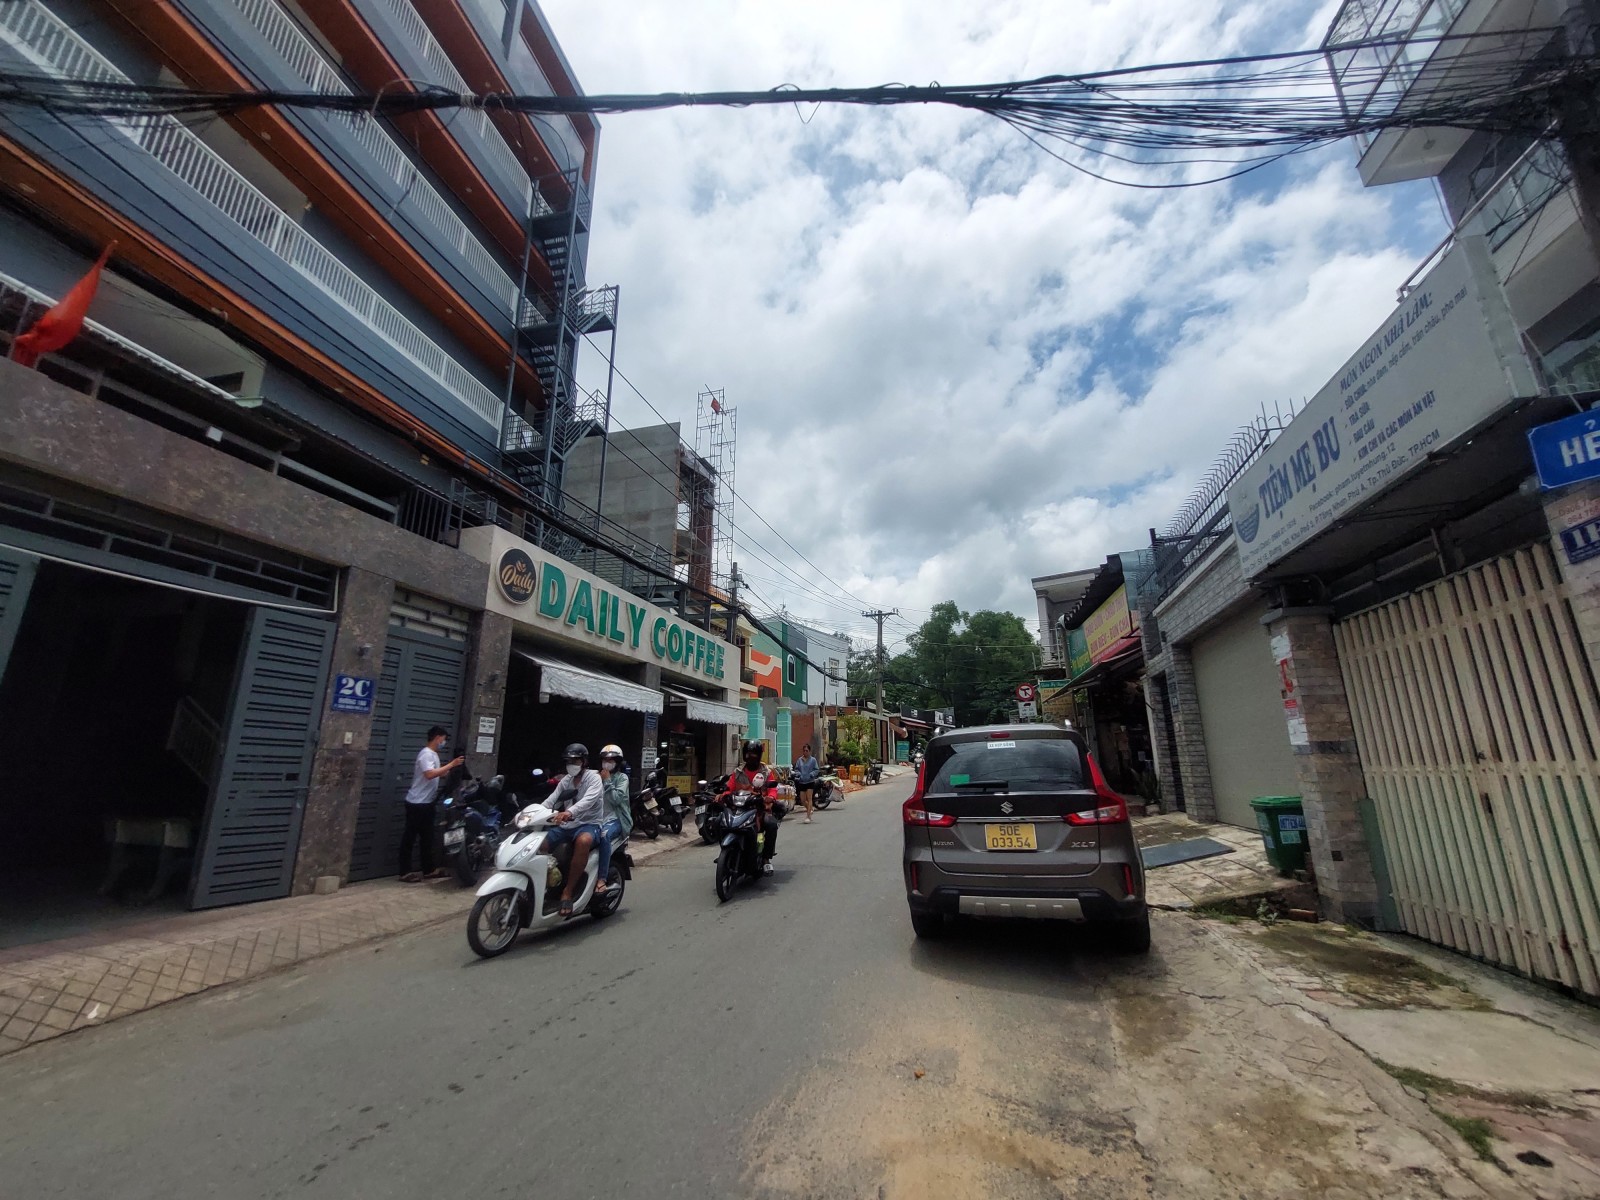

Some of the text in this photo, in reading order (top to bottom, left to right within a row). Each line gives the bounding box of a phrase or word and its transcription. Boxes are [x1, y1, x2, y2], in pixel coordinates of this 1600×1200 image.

[1408, 428, 1440, 457] TP.HCM
[1258, 416, 1340, 519] TIỆM MẸ BU
[501, 564, 535, 593] Daily
[537, 561, 725, 680] DAILY COFFEE
[338, 677, 371, 698] 2C
[992, 837, 1031, 848] 033.54
[1000, 826, 1020, 836] 50E
